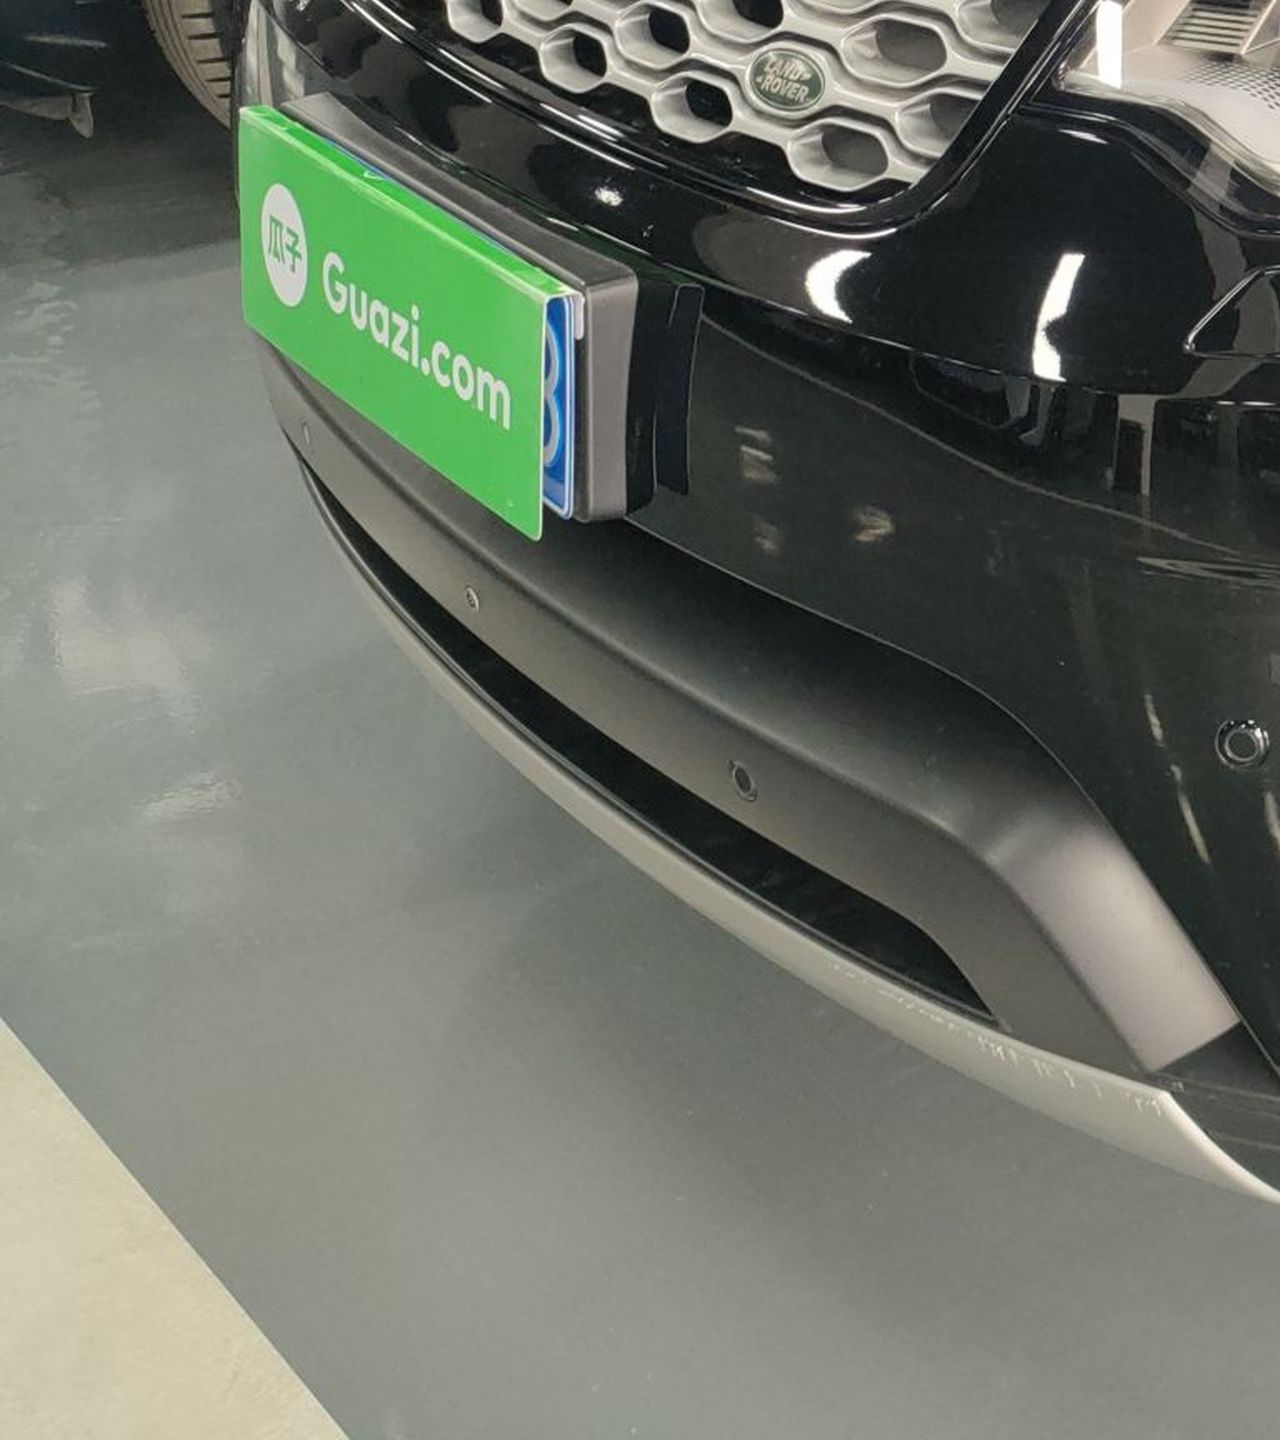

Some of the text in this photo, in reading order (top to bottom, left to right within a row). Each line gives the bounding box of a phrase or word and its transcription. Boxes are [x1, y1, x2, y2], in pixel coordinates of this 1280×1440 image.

[761, 75, 809, 103] ROVER
[763, 58, 803, 81] LAND
[267, 213, 303, 275] 瓜子
[321, 251, 512, 431] Guazi.com
